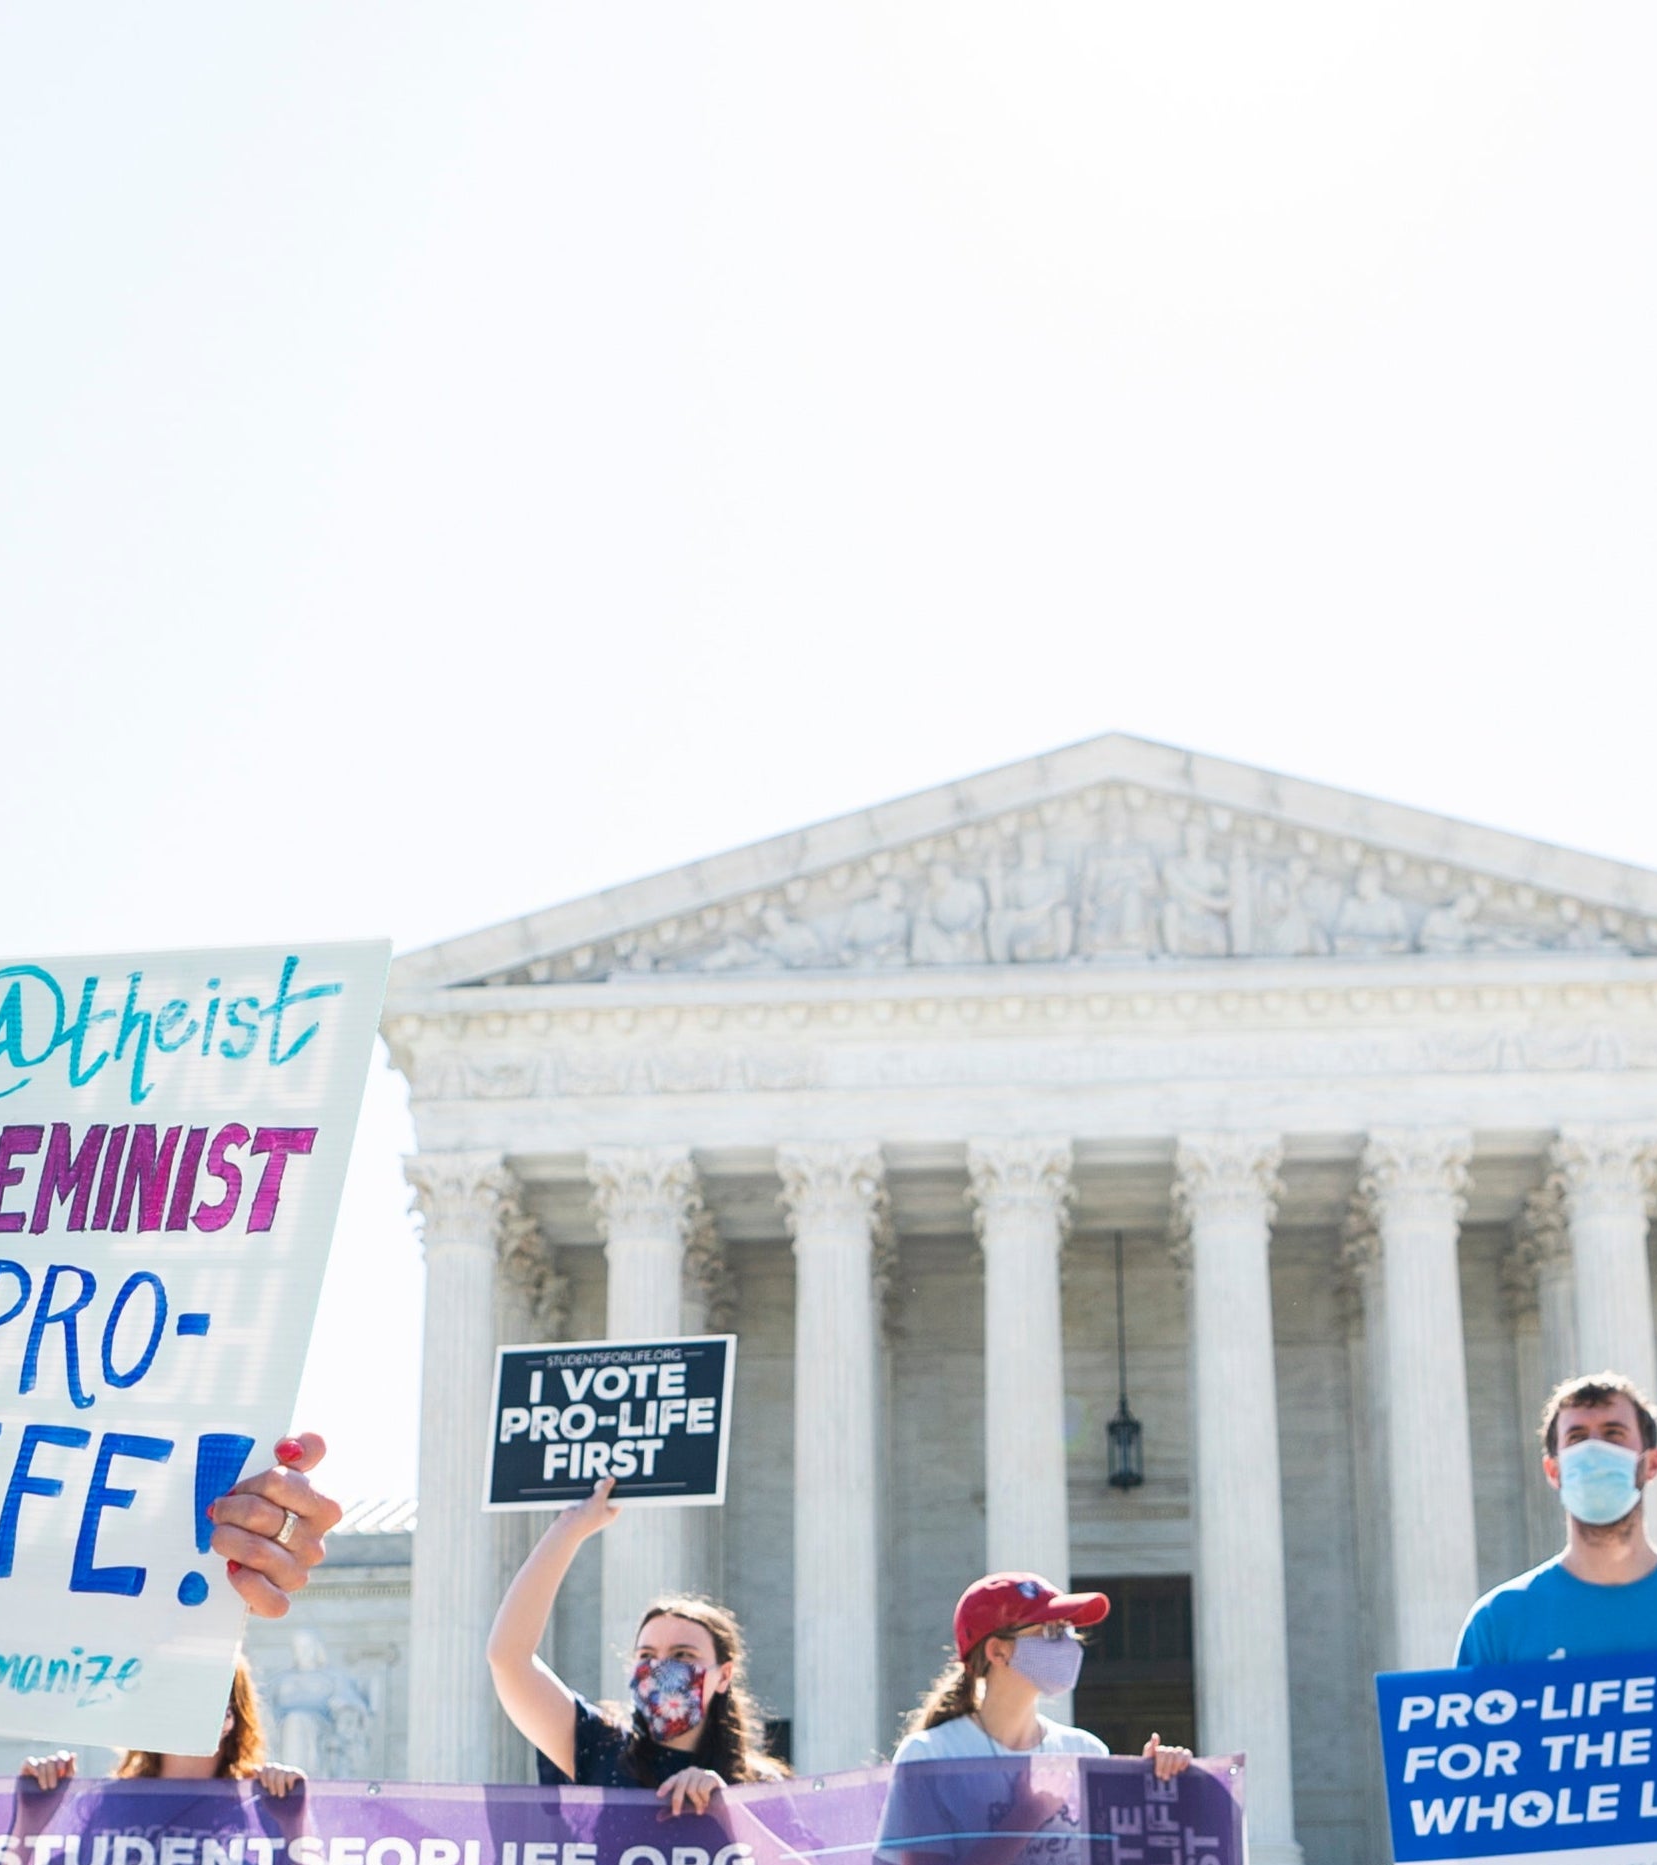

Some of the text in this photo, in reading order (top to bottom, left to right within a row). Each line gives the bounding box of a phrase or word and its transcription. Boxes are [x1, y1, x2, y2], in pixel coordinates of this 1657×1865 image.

[546, 1348, 682, 1369] STUDENTSFORLIFE.ORG
[529, 1363, 686, 1404] I VOTE
[499, 1397, 716, 1443] PRO-LIFE
[543, 1438, 664, 1481] FIRST
[1397, 1676, 1656, 1732] PRO-LIFE
[1403, 1728, 1653, 1784] FOR THE
[1409, 1783, 1622, 1836] WHOLE
